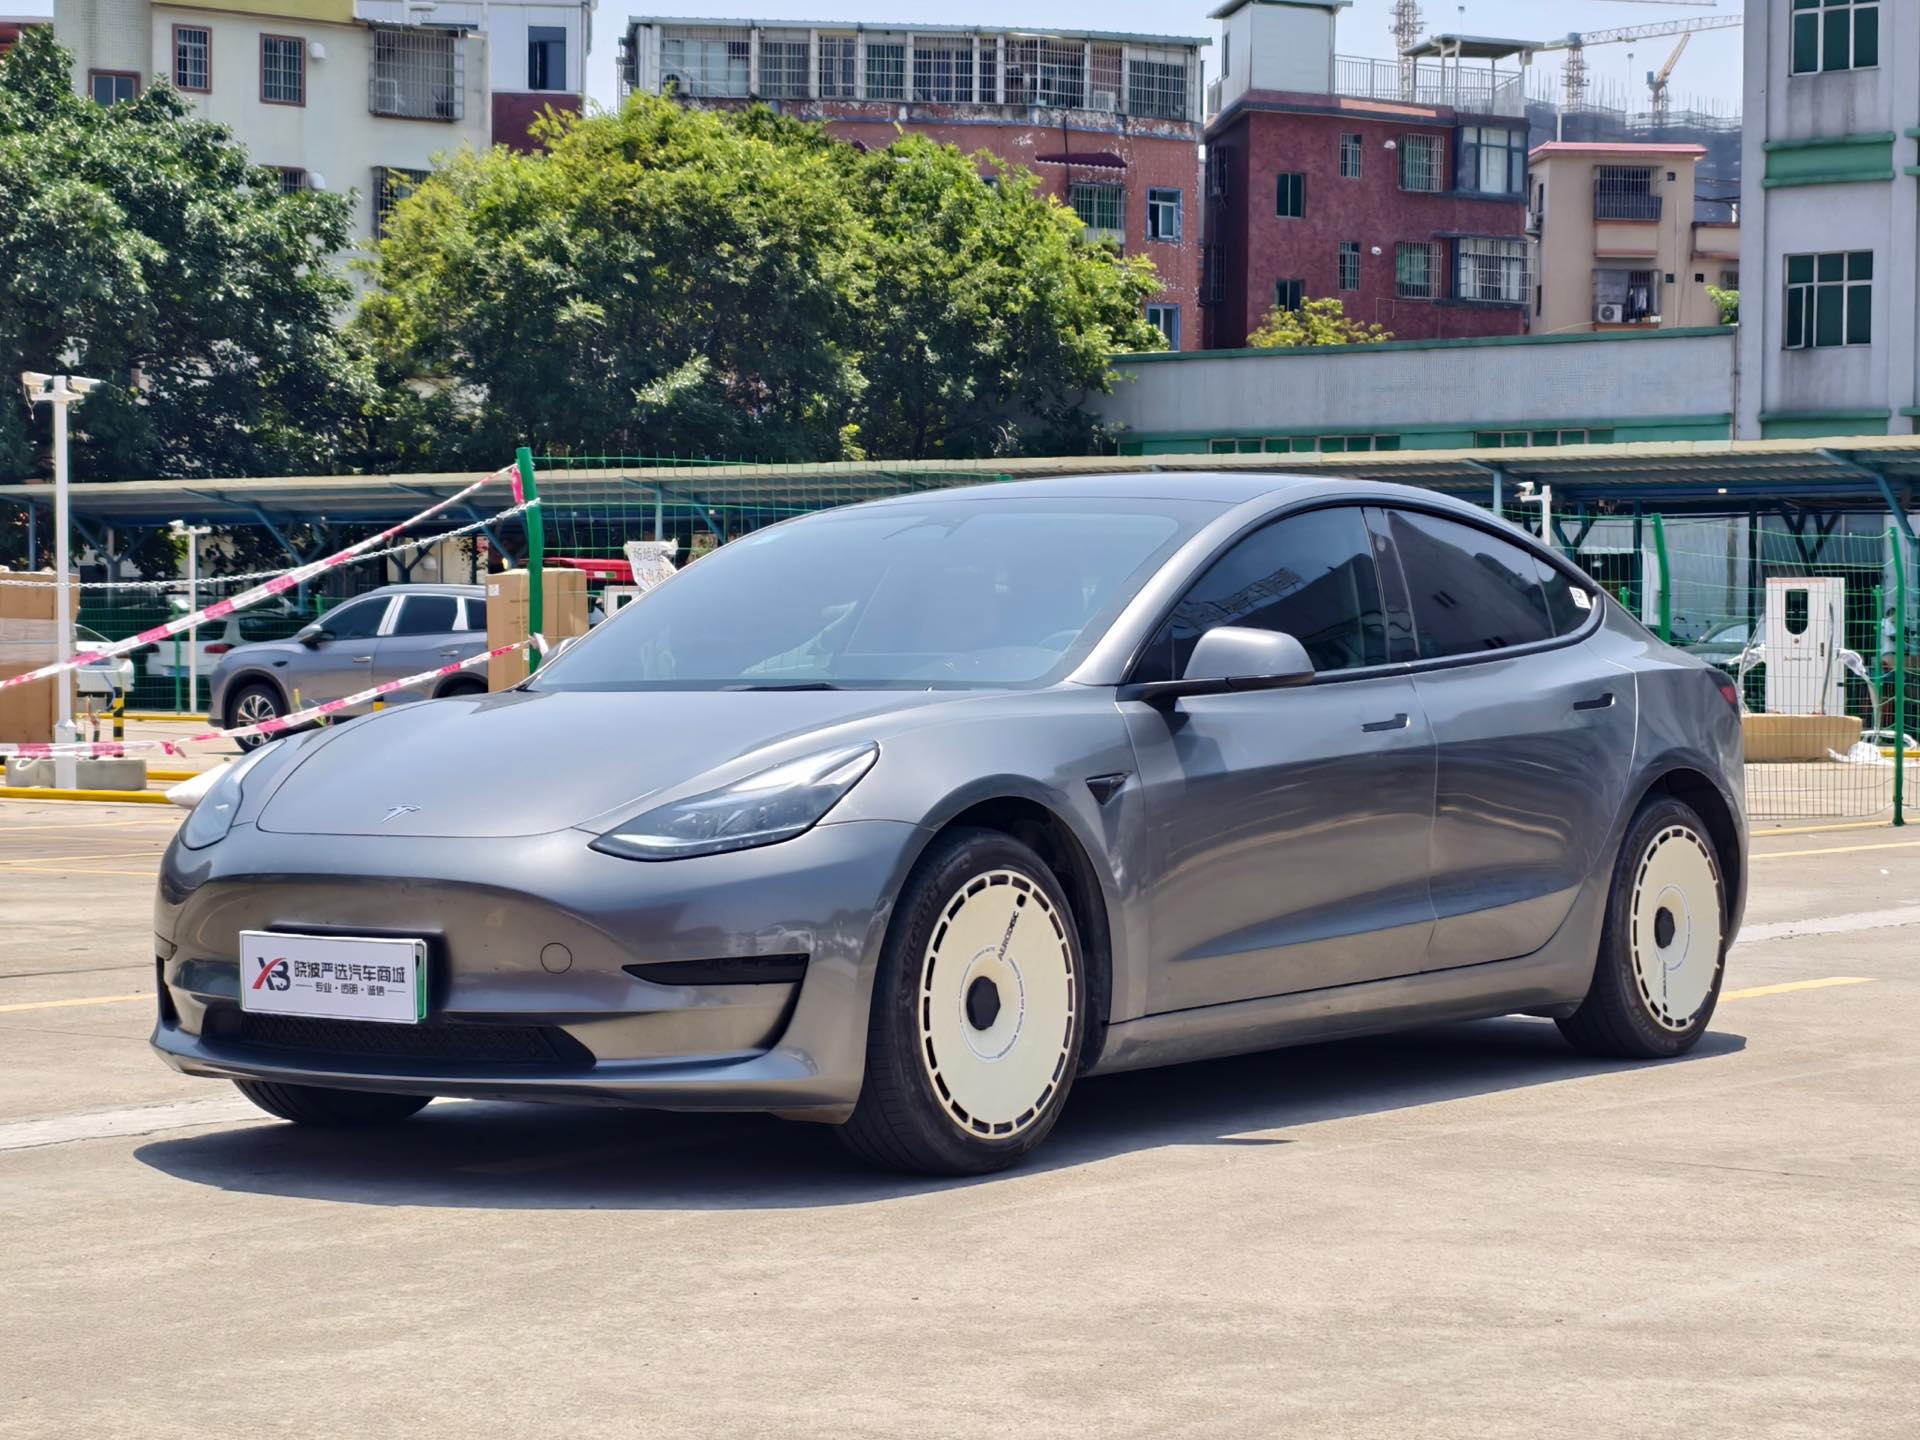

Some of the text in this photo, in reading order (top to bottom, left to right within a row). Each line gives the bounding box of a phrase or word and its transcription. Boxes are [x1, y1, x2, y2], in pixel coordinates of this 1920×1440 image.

[294, 960, 406, 983] 晓波严选汽车商城
